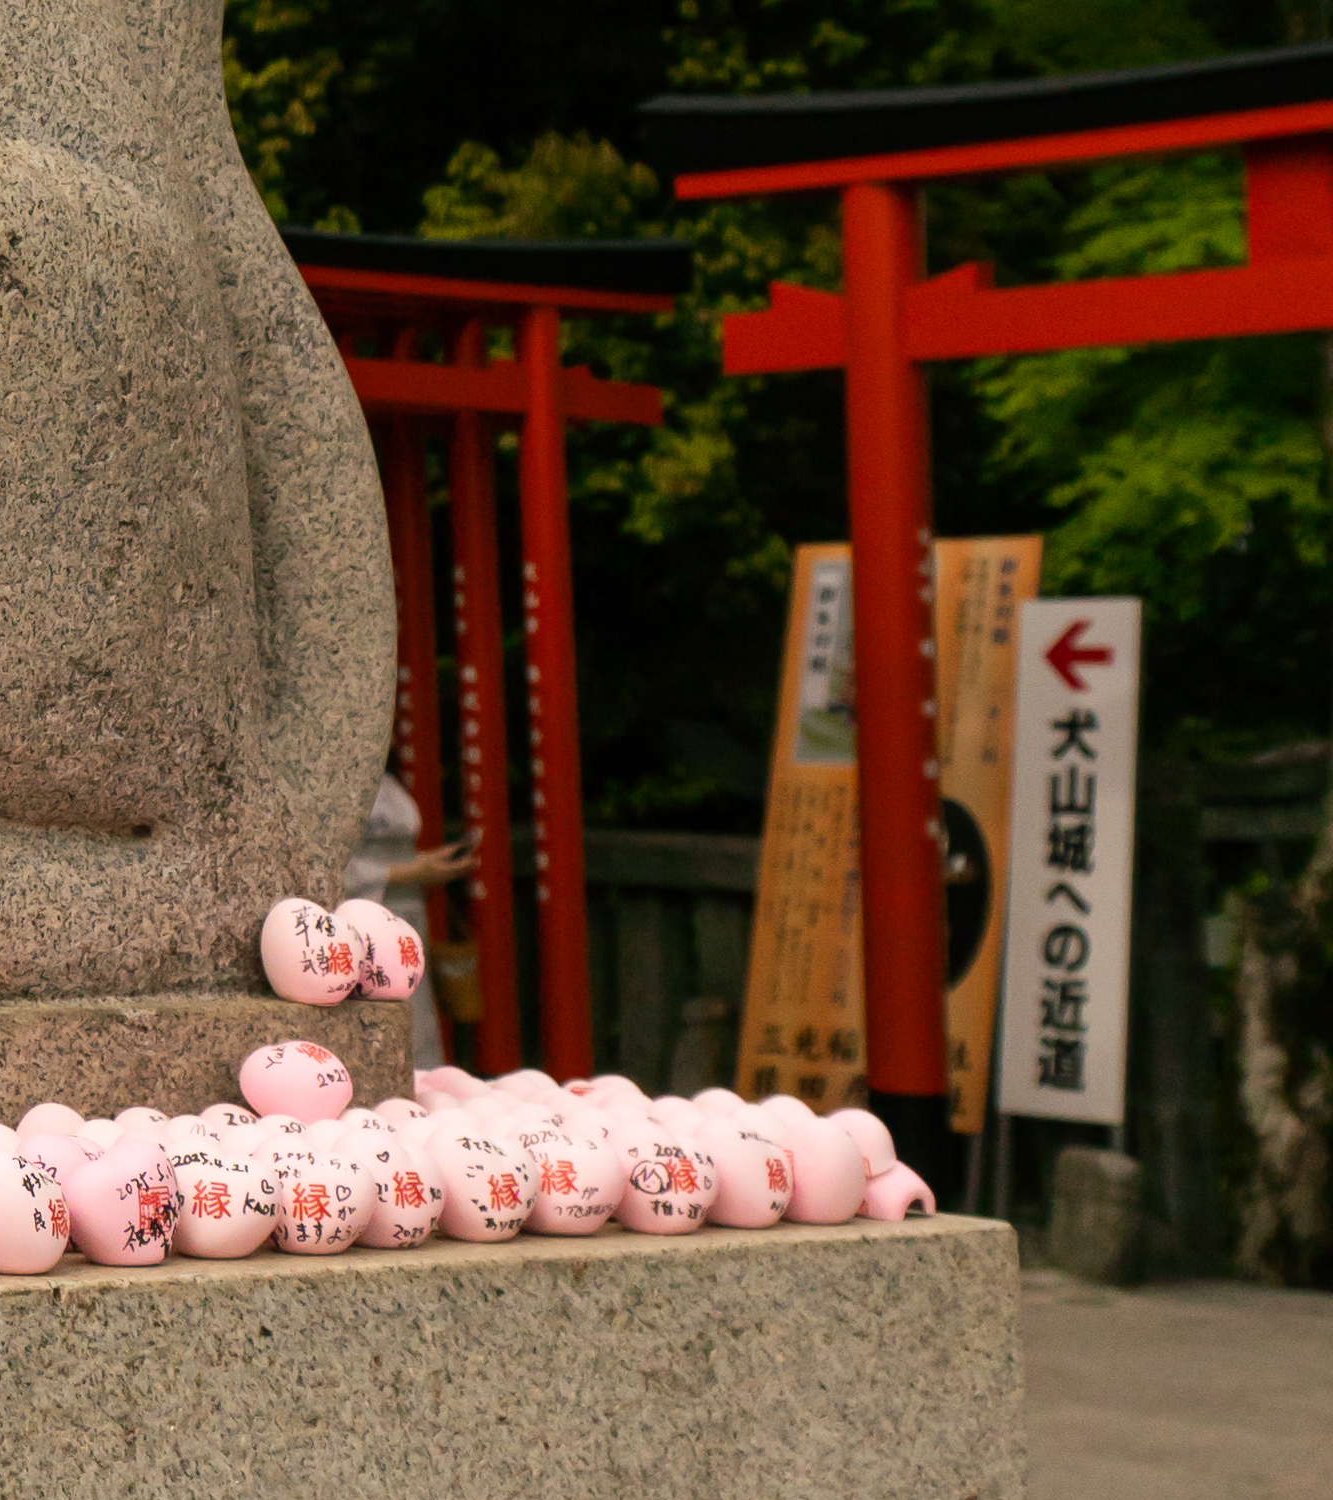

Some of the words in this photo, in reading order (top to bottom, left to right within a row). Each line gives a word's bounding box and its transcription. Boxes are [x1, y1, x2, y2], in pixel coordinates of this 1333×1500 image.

[1036, 706, 1100, 1094] 犬山城への近道
[327, 941, 354, 976] 縁
[397, 935, 421, 968] 縁
[392, 1171, 428, 1210] 縁
[487, 1173, 523, 1212] 縁
[540, 1159, 579, 1196] 縁
[666, 1159, 700, 1194] 縁
[191, 1179, 232, 1220] 縁
[291, 1182, 332, 1222] 縁
